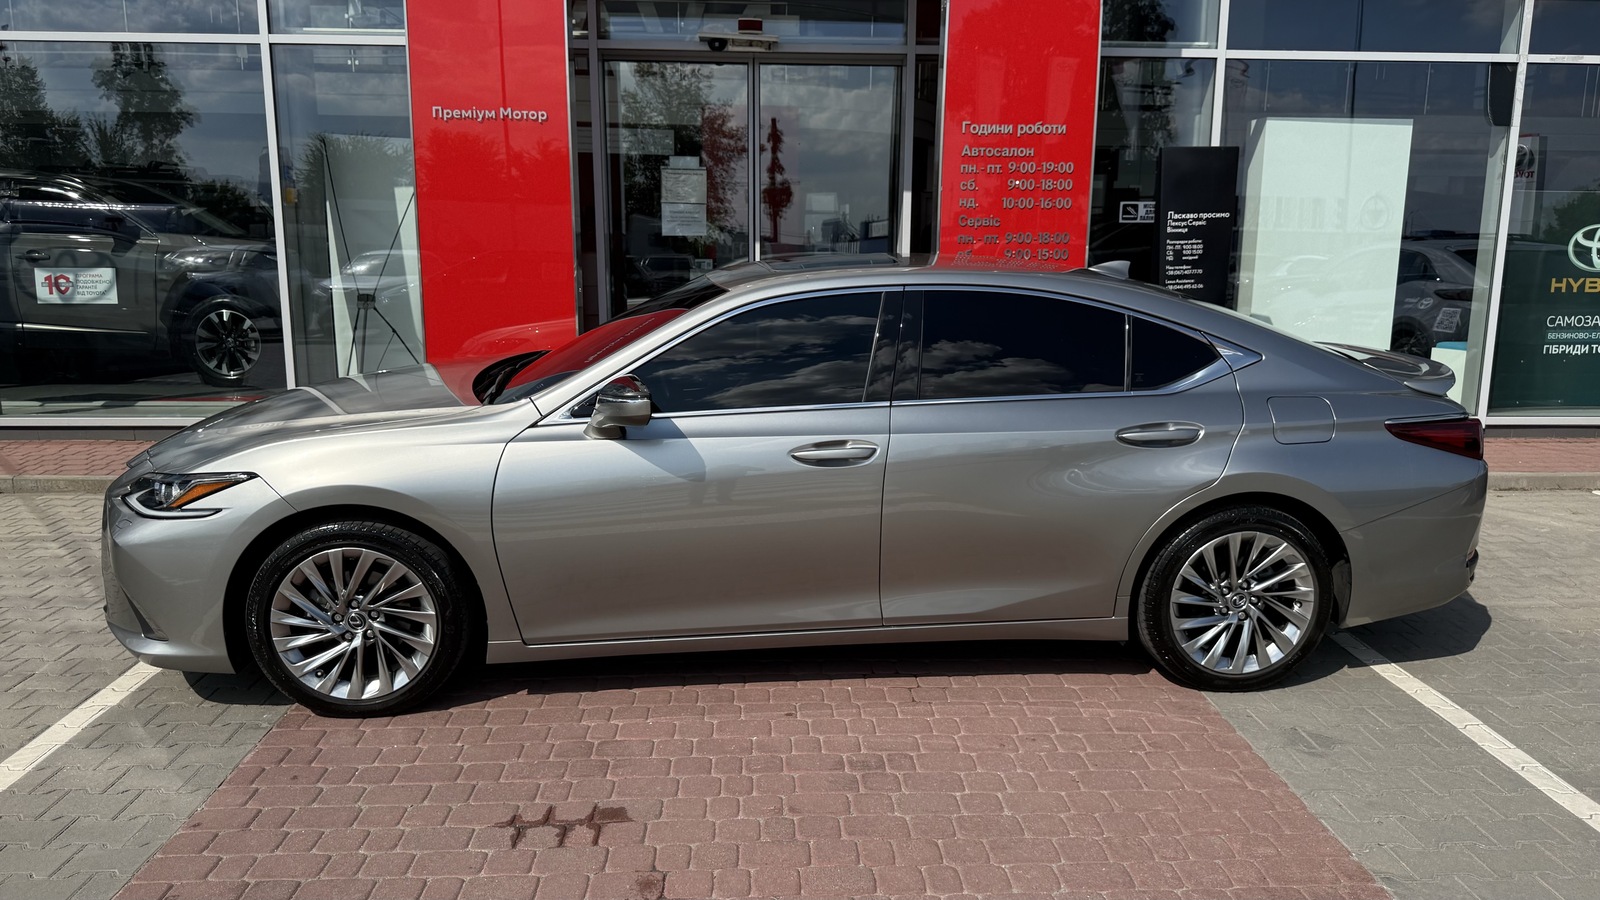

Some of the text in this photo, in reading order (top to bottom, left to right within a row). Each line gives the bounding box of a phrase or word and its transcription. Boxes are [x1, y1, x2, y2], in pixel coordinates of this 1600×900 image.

[432, 106, 548, 122] Преміум Мотор
[961, 121, 1067, 137] Години роботи
[961, 145, 1035, 157] Автосалон
[960, 179, 979, 191] сб.
[959, 198, 979, 209] нд.
[1167, 211, 1230, 220] Ласкаво просимо
[958, 215, 1001, 229] Сервіс
[44, 274, 70, 295] 10
[1543, 344, 1590, 356] ГІБРИДИ
